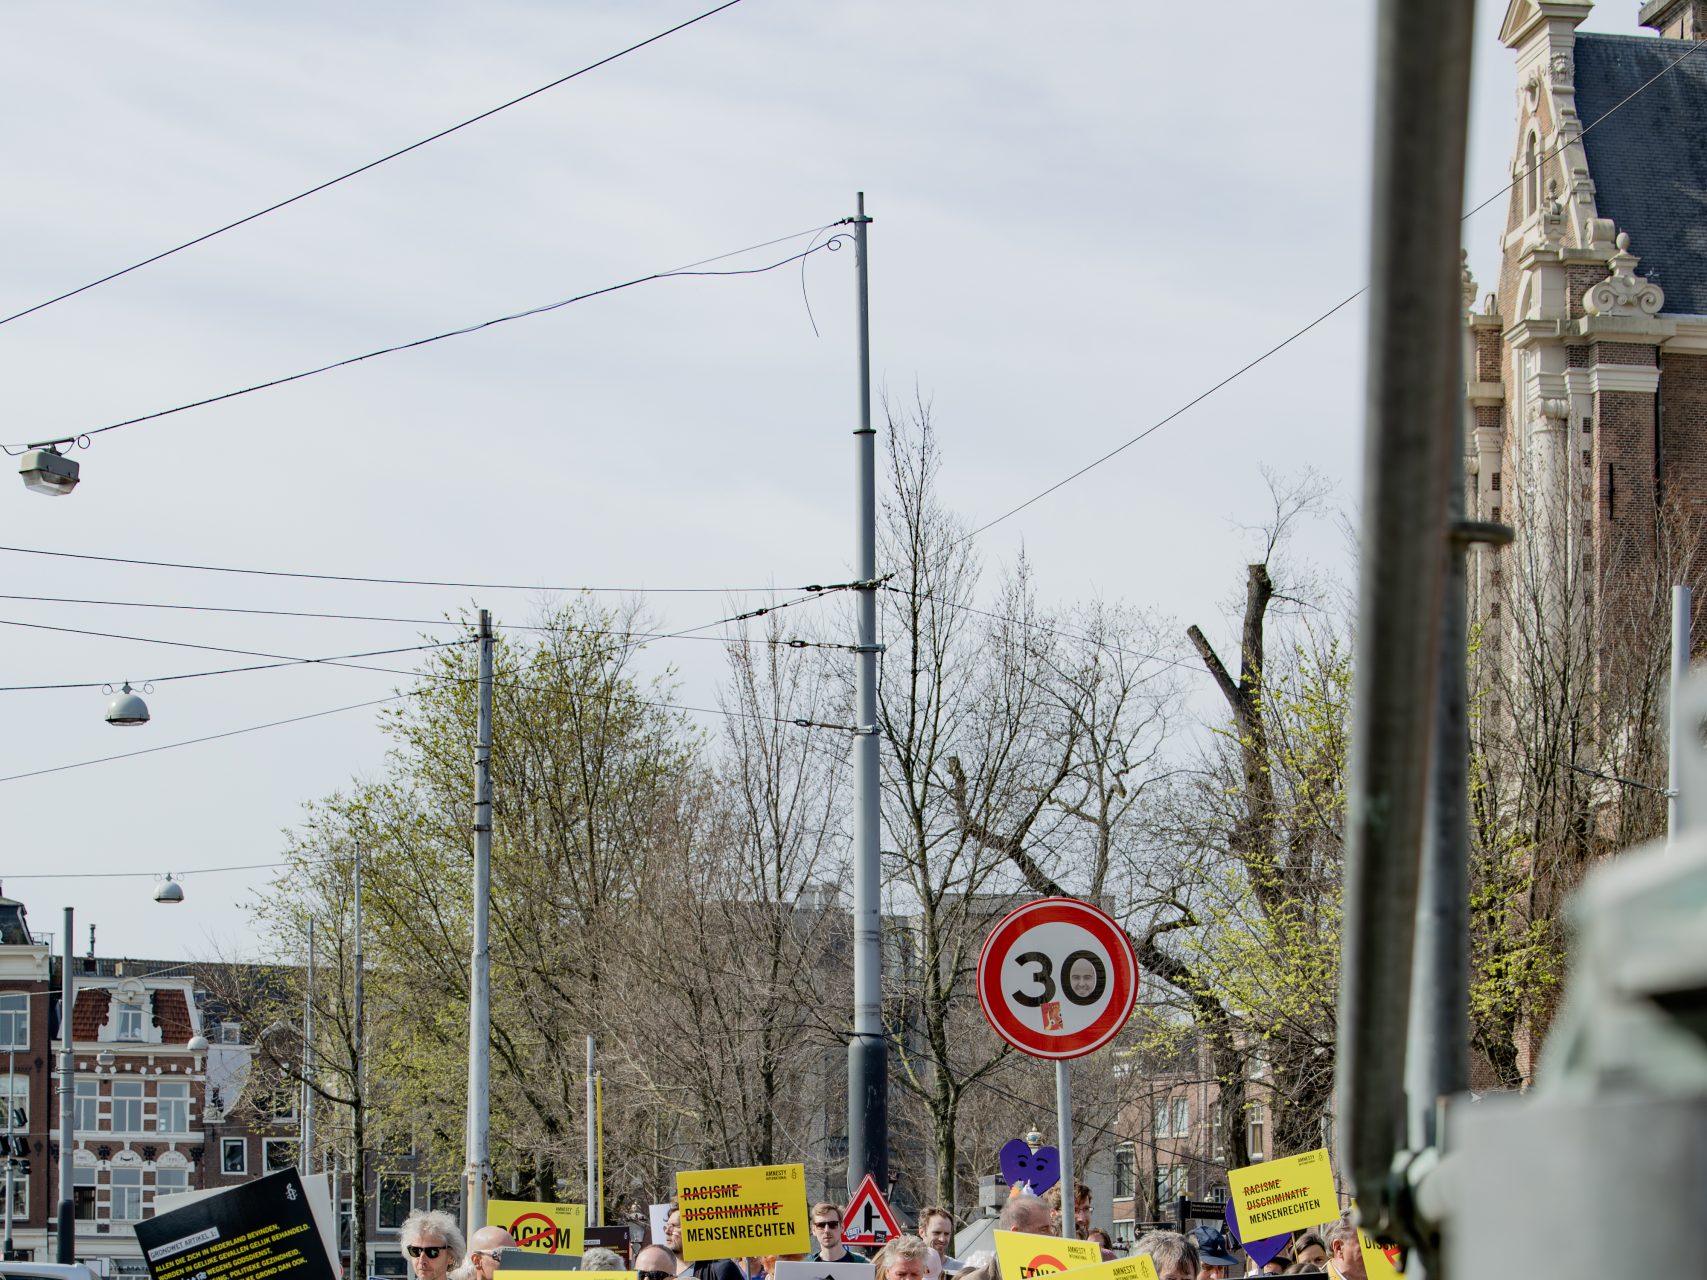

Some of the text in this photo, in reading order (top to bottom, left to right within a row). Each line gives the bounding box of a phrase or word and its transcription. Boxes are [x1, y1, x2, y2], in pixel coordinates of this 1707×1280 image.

[1012, 950, 1106, 1008] 30
[684, 1184, 739, 1201] RACISME
[1244, 1179, 1281, 1196] RACISME
[1247, 1187, 1309, 1211] DISCRIMINATIE
[685, 1202, 779, 1222] DISCRIMINATIE
[1250, 1199, 1321, 1225] MENSENRECHTEN
[497, 1225, 571, 1249] ACISM
[687, 1222, 795, 1242] MENSENRECHTEN
[151, 1242, 183, 1259] GRONDWET
[185, 1233, 209, 1246] ARTIKEL
[156, 1261, 175, 1273] ALLEN
[175, 1257, 187, 1265] DIE
[186, 1252, 202, 1262] ZICH
[210, 1235, 247, 1254] NEDERLAND
[247, 1224, 280, 1240] BEVINDEN,
[194, 1258, 218, 1270] GELIJKE
[219, 1245, 250, 1261] GEVALLEN
[250, 1237, 272, 1250] GELIJK
[271, 1224, 311, 1242] BEHANDELD.
[1068, 1246, 1086, 1254] AMNESTY
[207, 1263, 232, 1275] WEGENS
[233, 1248, 273, 1266] GODSDIENST,
[230, 1262, 262, 1278] POLITIEKE
[256, 1268, 278, 1280] GROND
[278, 1263, 292, 1272] DAN
[1113, 1265, 1137, 1277] AMNESTY
